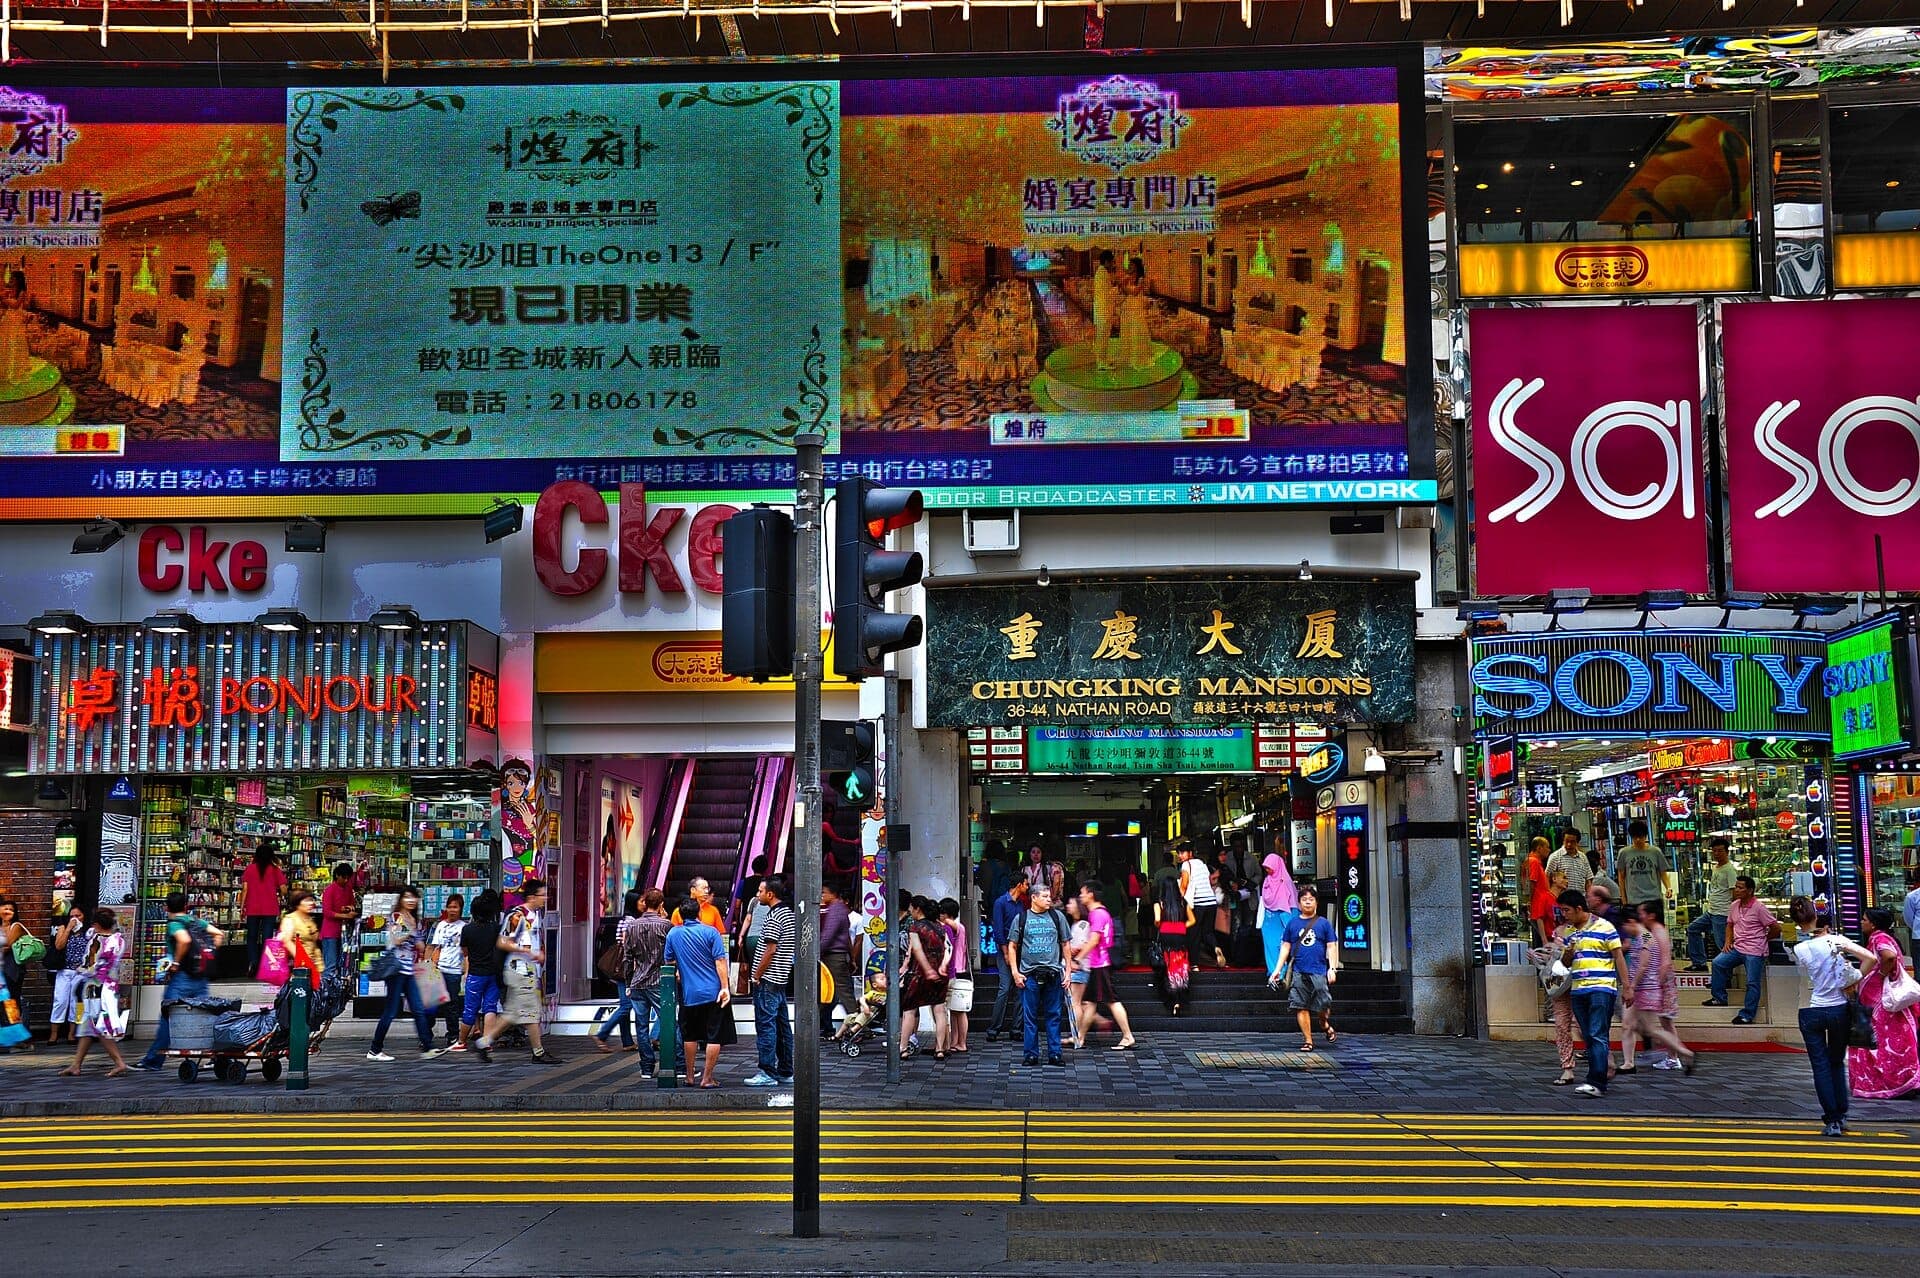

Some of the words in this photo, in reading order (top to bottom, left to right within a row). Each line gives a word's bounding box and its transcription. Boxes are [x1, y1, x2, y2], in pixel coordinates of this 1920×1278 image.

[0, 113, 51, 158] 府
[520, 131, 627, 167] 煌府
[1024, 176, 1215, 210] 婚宴專門店
[487, 219, 541, 229] Wedding
[599, 217, 658, 229] Specialist
[1026, 222, 1085, 236] Wedding
[1090, 221, 1146, 236] Banquet
[1151, 219, 1216, 235] Specialist
[32, 233, 100, 248] Specialist
[449, 283, 693, 326] 現已開業
[417, 344, 721, 373] 歡迎全城新人親臨
[549, 390, 698, 411] 21806178
[1004, 418, 1047, 439] 煌府
[1211, 484, 1255, 501] JM
[1266, 481, 1420, 501] NETWORK
[138, 525, 268, 592] Cke
[1471, 649, 1824, 719] SONY
[1823, 651, 1892, 697] SONY
[972, 677, 1181, 699] CHUNGKING
[1199, 675, 1372, 698] MANSIONS
[221, 675, 420, 722] BONJOUR
[1007, 703, 1051, 719] 36-44,
[1056, 701, 1122, 717] NATHAN
[1125, 700, 1171, 716] ROAD
[1045, 728, 1144, 738] CHUNGKING
[1148, 728, 1234, 737] MANSIONS
[1072, 761, 1104, 769] Nathan
[1134, 761, 1154, 769] Tsim
[1157, 761, 1174, 769] Sha
[1200, 761, 1234, 769] Kowloon
[1651, 749, 1684, 770] Nikon
[1685, 742, 1729, 766] Canon
[1665, 821, 1696, 831] APPLE
[1343, 941, 1367, 949] CHANGE
[1680, 976, 1710, 987] FREE
